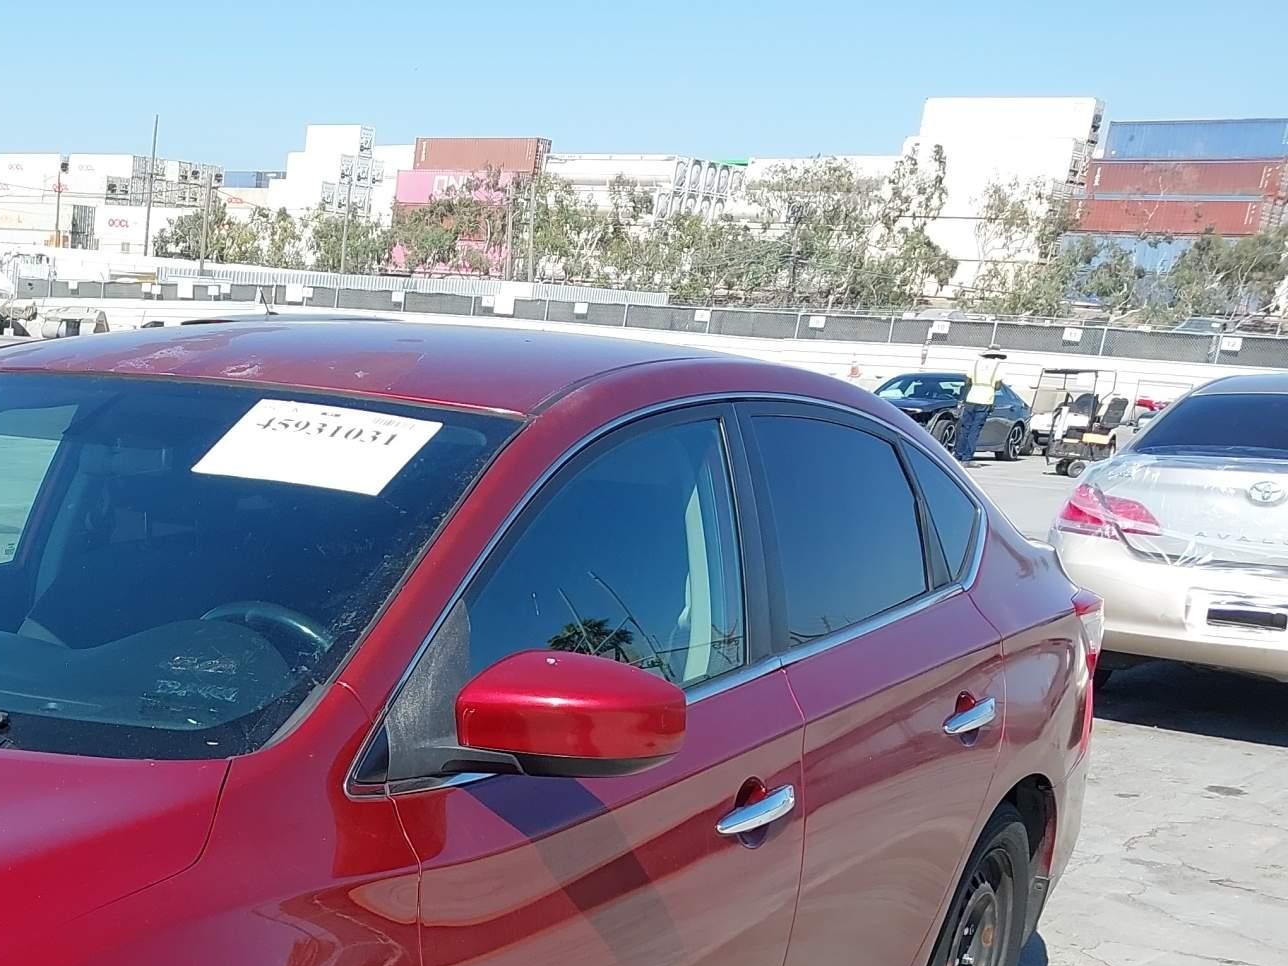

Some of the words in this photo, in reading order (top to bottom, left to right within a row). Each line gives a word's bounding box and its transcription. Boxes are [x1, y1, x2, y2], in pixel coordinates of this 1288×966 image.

[108, 218, 129, 228] OOCL
[256, 417, 398, 446] 45931031
[1195, 531, 1288, 547] AVAL
